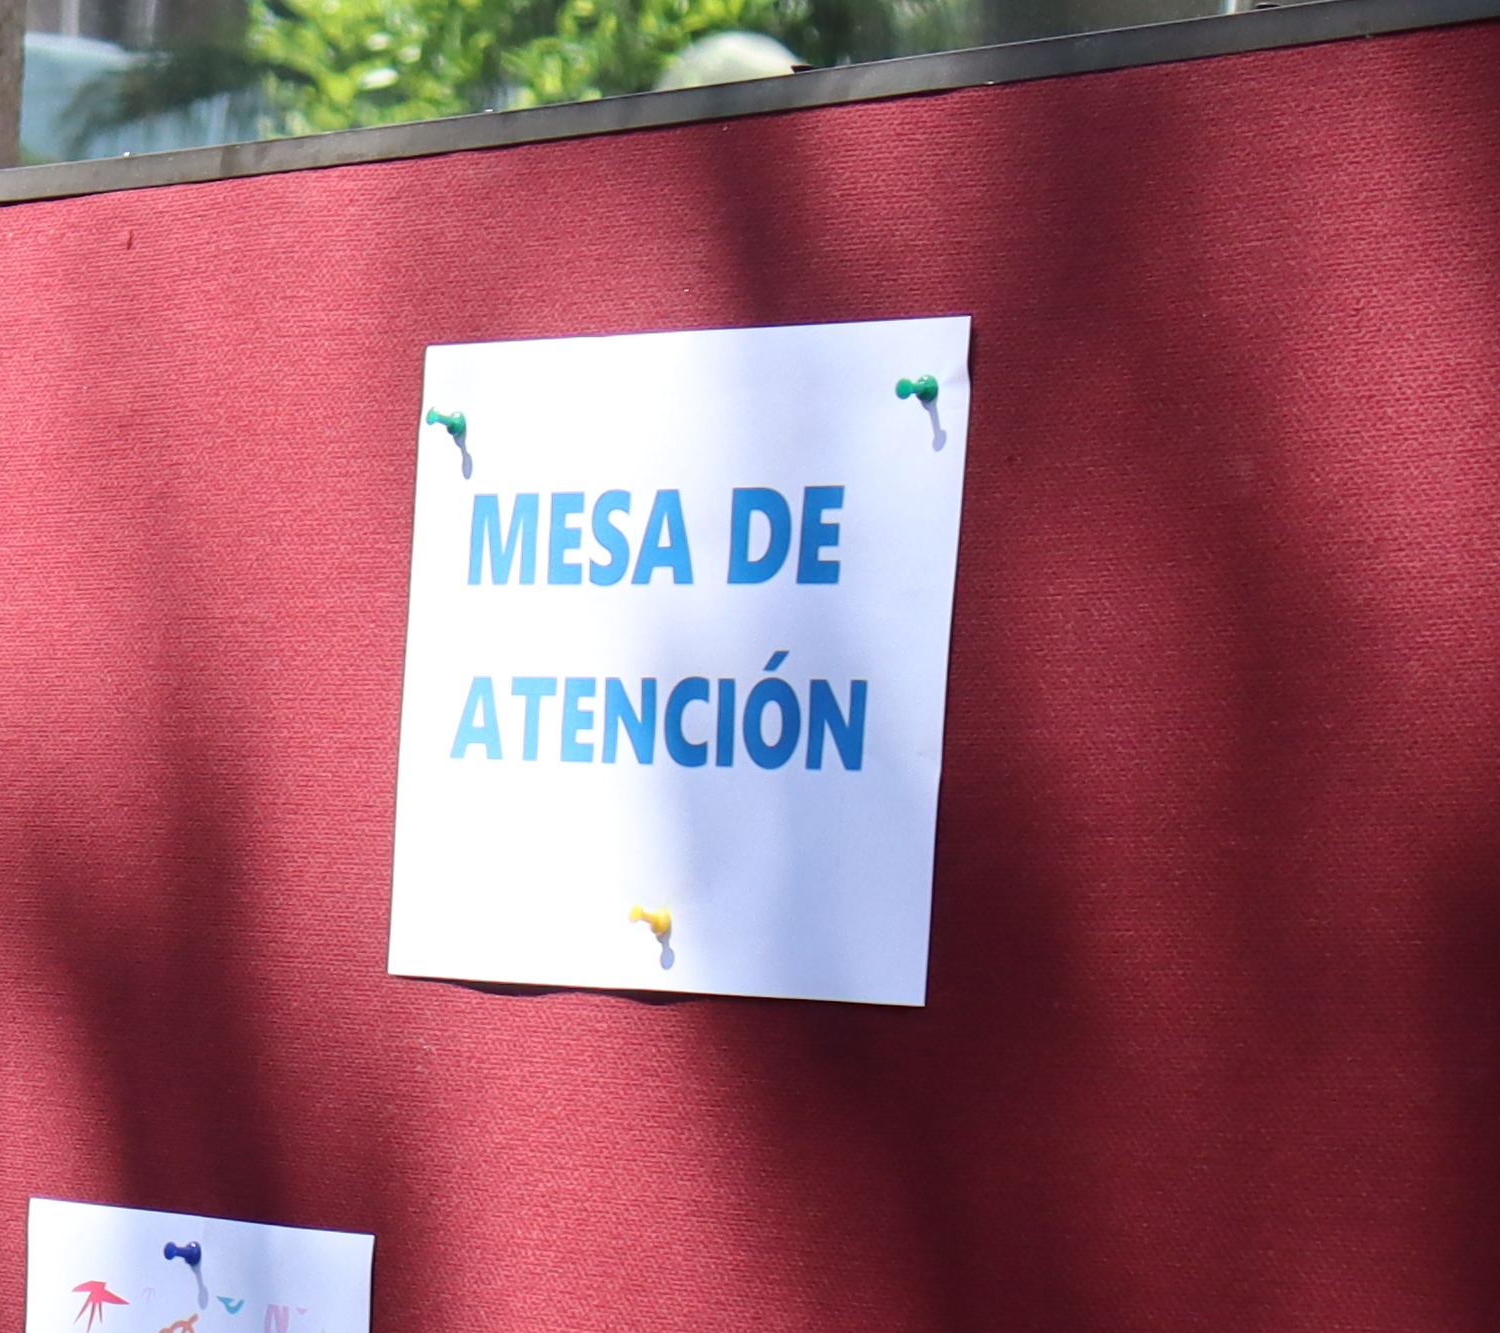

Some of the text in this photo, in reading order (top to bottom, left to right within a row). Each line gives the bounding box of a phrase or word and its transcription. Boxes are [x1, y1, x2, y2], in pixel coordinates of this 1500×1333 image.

[467, 485, 846, 587] MESA DE
[450, 651, 869, 772] ATENCIÓN
